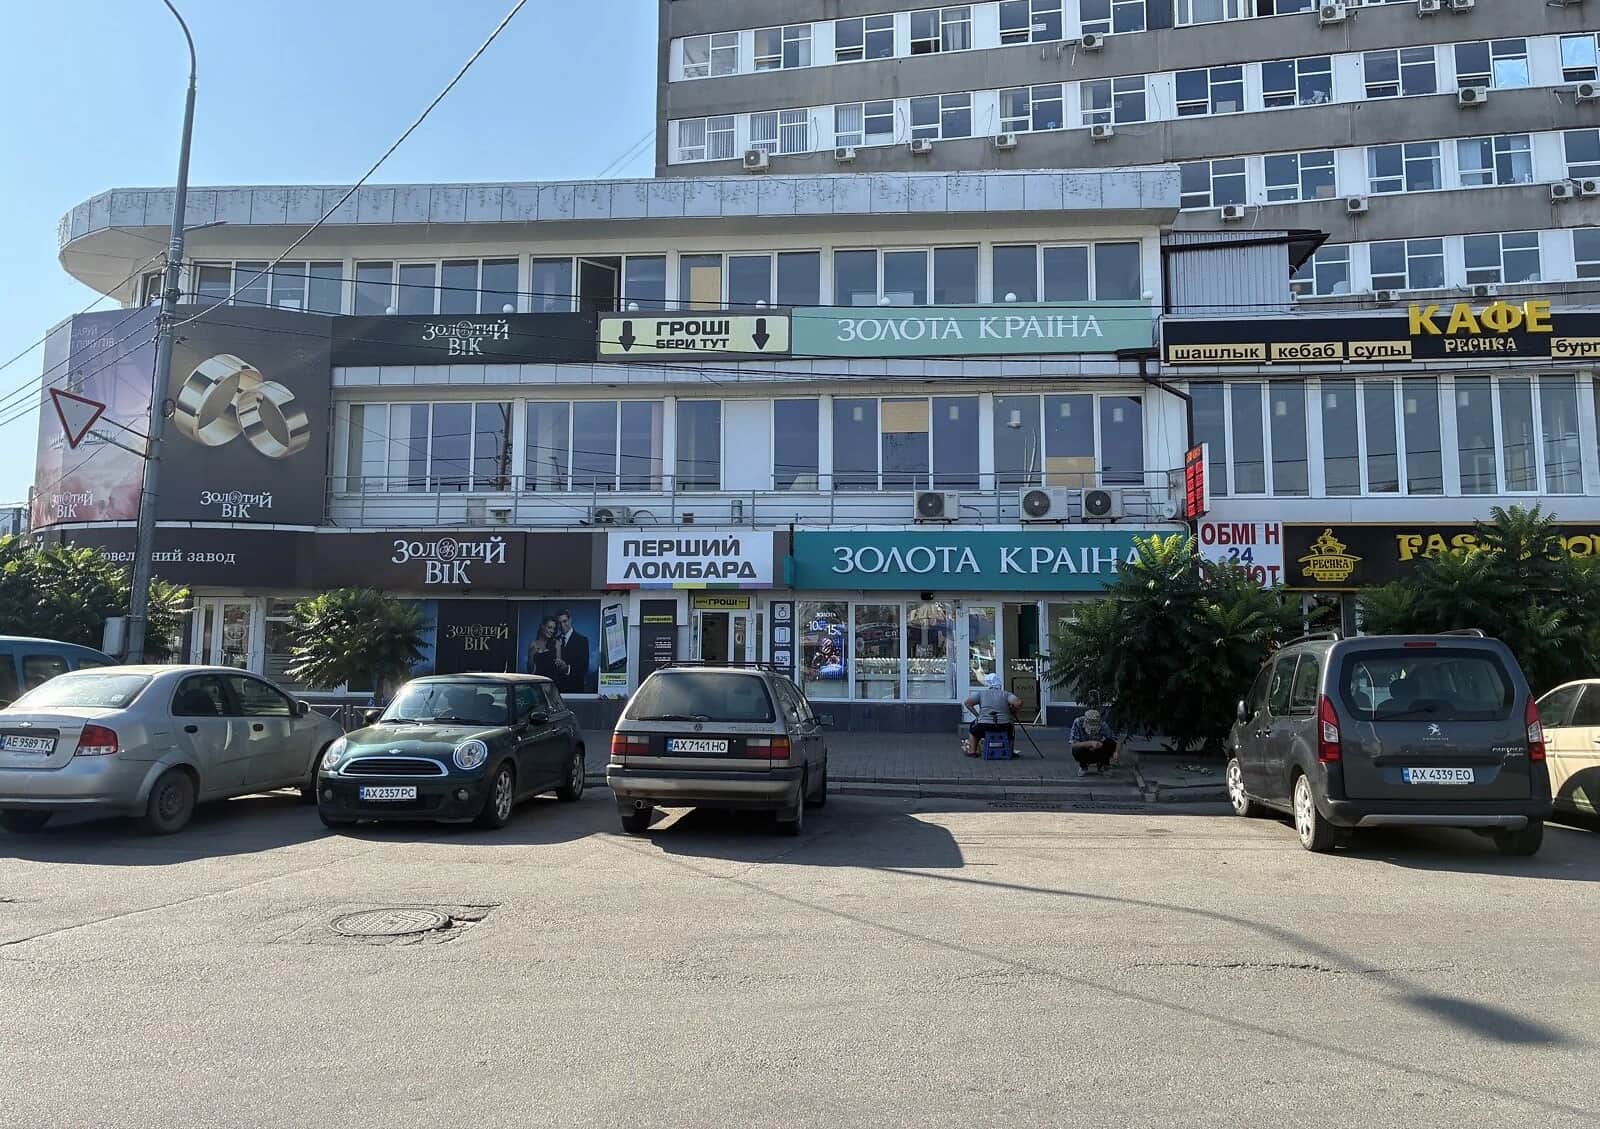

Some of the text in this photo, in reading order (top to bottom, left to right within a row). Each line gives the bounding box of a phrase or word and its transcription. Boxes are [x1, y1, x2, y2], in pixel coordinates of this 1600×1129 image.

[1408, 300, 1553, 335] КАФЕ
[656, 320, 730, 336] ГРОШІ
[837, 317, 964, 342] ЗОЛОТА
[656, 338, 730, 349] БЕРИ ТУТ
[1278, 343, 1336, 359] кебаб
[1174, 346, 1260, 360] шашлык
[1353, 343, 1407, 361] супы
[623, 535, 741, 557] ПЕРШИЙ
[187, 552, 236, 565] завод
[832, 546, 981, 574] ЗОЛОТА
[1228, 546, 1253, 564] 24
[623, 561, 757, 579] ЛОМБАРД
[6, 736, 18, 746] AE
[40, 739, 52, 750] TK
[673, 740, 687, 751] AX
[689, 740, 710, 751] 7141
[1412, 769, 1471, 781] AX 4339 EO
[365, 788, 415, 798] AX 2357 PC
